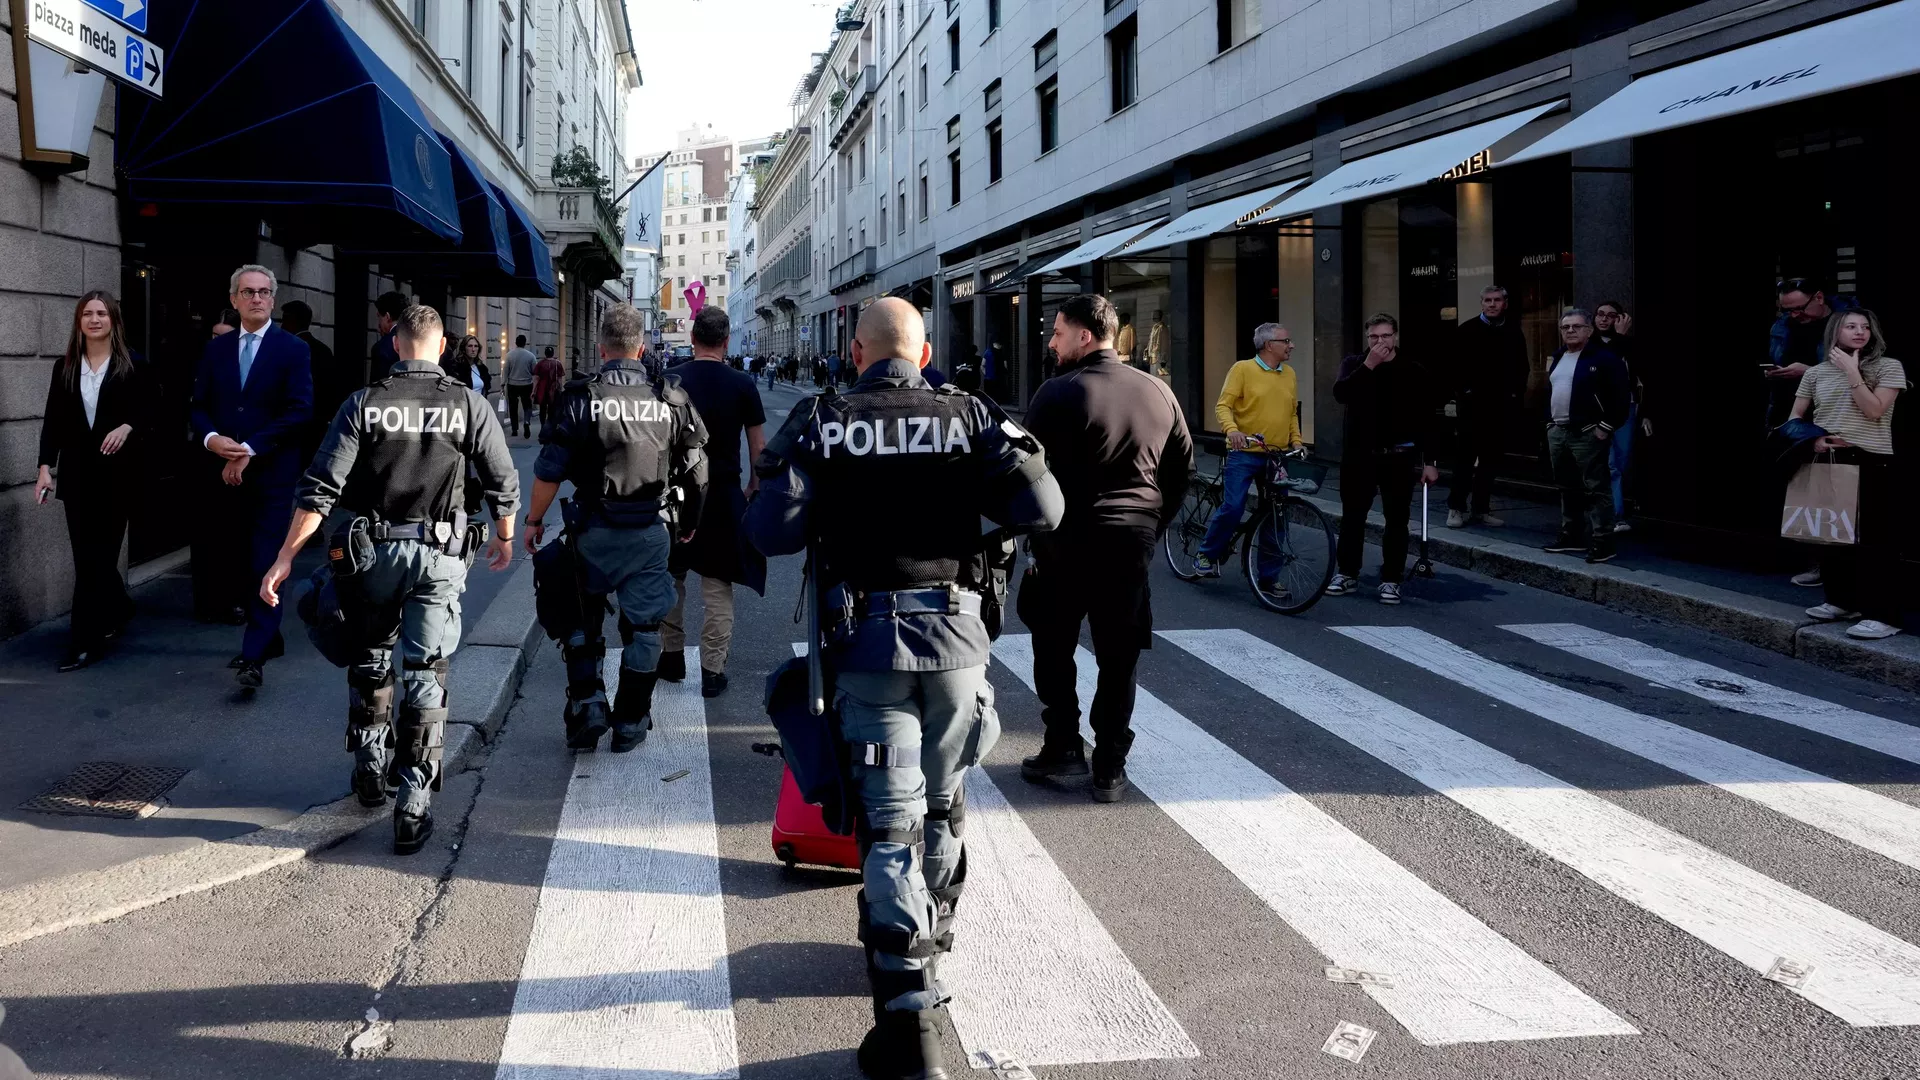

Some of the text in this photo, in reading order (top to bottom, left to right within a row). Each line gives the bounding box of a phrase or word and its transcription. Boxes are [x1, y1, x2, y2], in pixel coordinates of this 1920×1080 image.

[34, 2, 74, 36] piazza
[79, 22, 117, 59] meda
[1658, 64, 1822, 114] CHANEL
[364, 406, 466, 435] POLIZIA
[590, 399, 672, 423] POLIZIA
[822, 416, 971, 459] POLIZIA
[1780, 505, 1856, 543] ZARA
